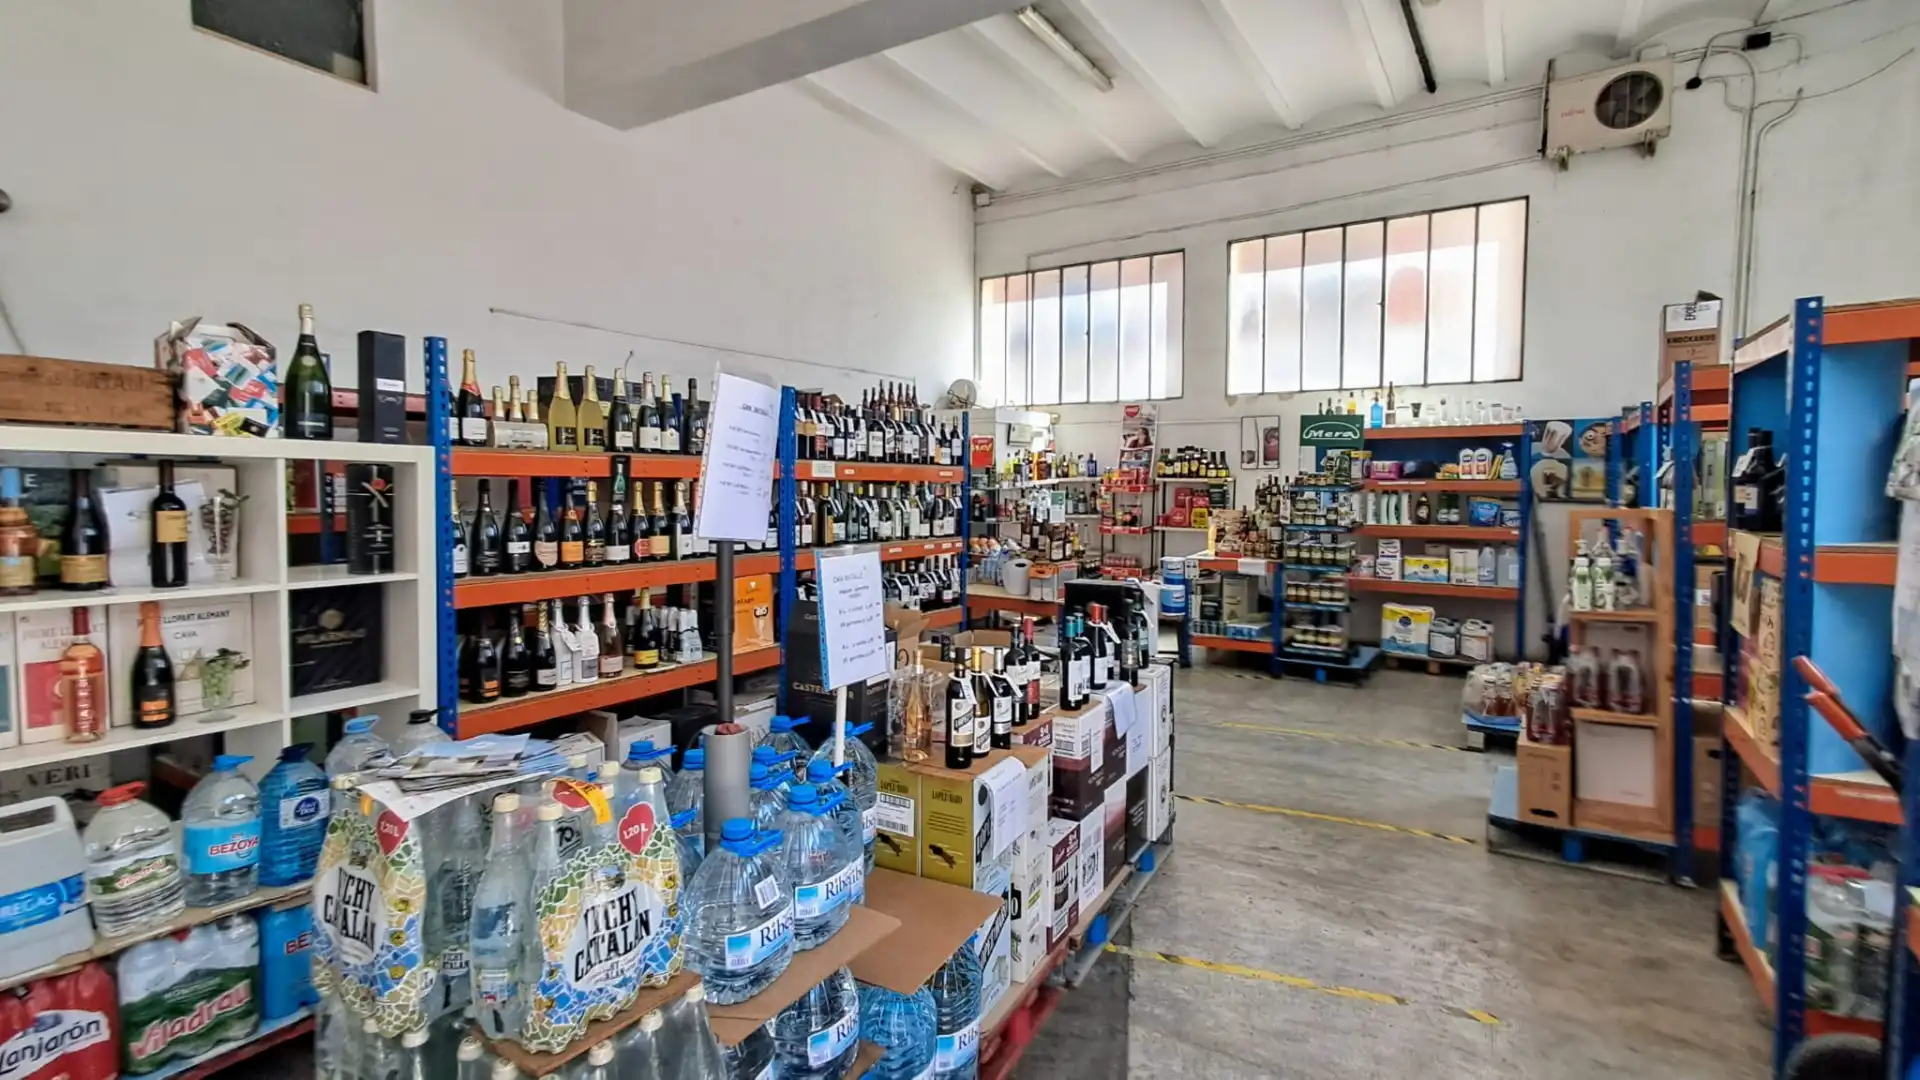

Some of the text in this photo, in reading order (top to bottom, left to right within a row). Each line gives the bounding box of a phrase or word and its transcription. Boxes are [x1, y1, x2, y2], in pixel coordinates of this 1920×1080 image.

[1309, 429, 1354, 438] Mera
[173, 630, 198, 640] CAVA
[26, 764, 91, 787] VERI
[209, 838, 260, 856] BEZOYA
